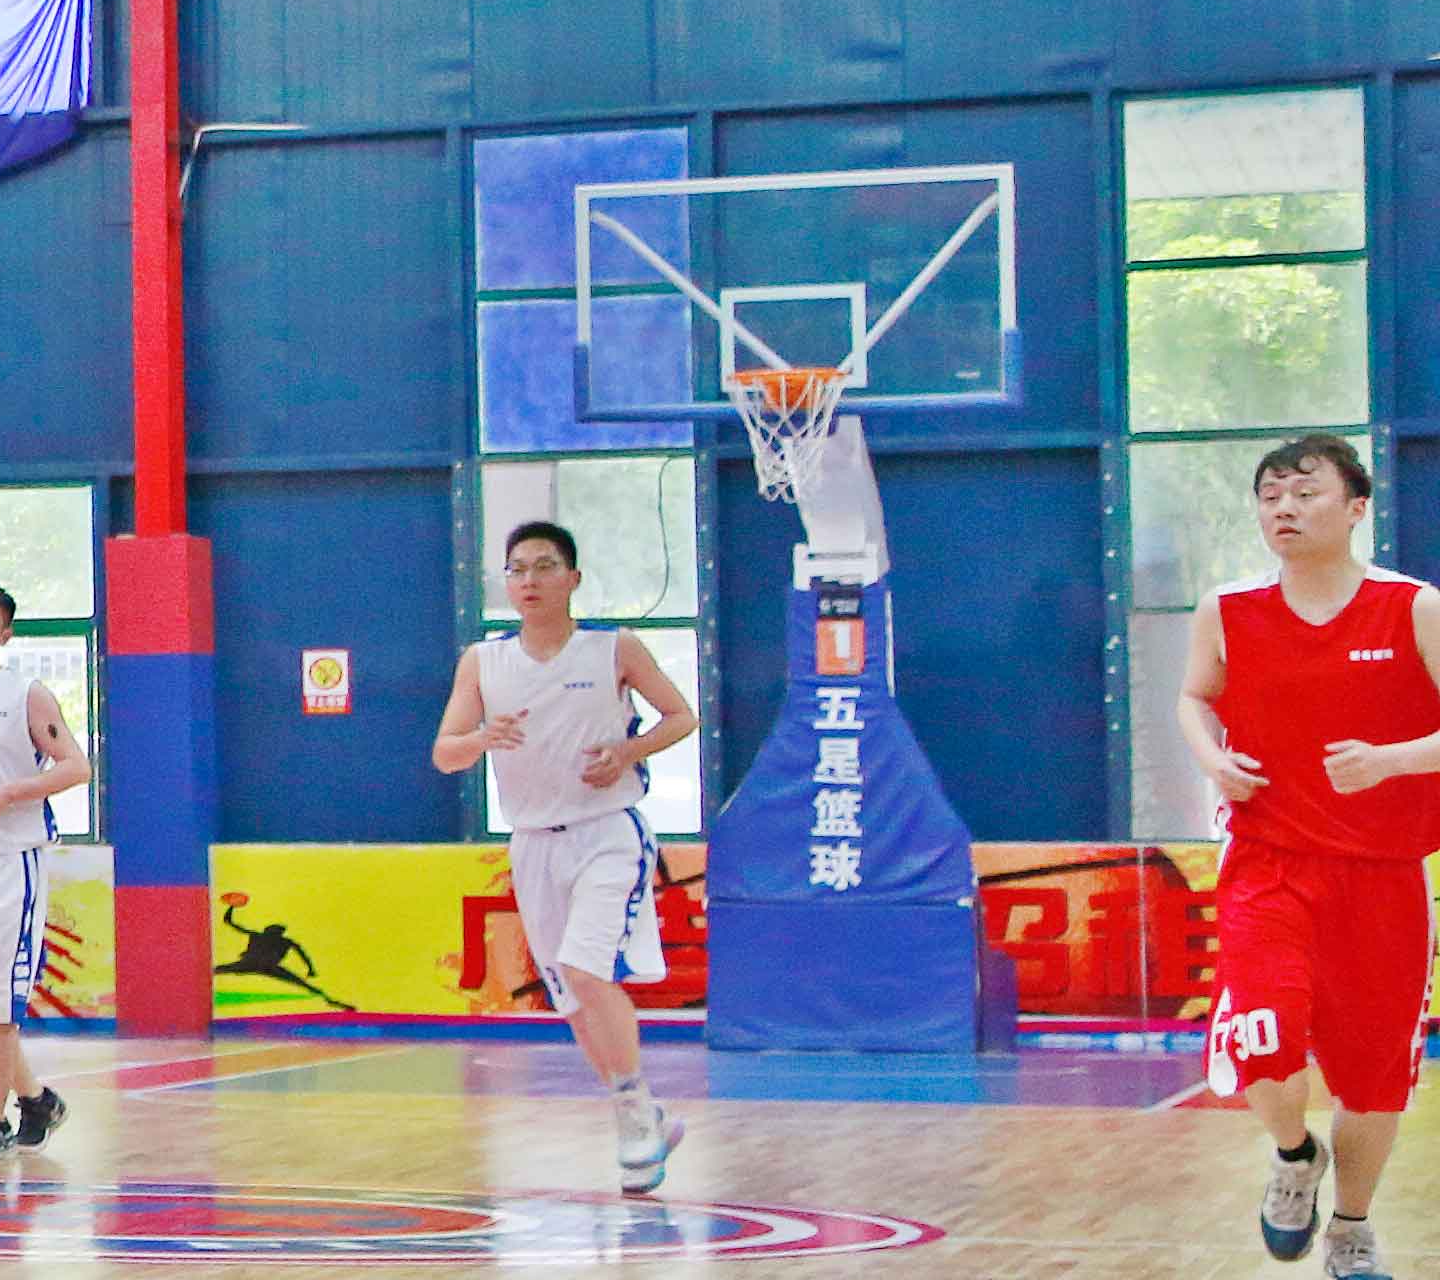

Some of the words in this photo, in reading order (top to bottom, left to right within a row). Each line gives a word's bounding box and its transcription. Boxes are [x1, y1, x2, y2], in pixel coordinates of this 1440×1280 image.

[809, 685, 866, 892] 五星篮球
[1230, 1007, 1281, 1063] 30
